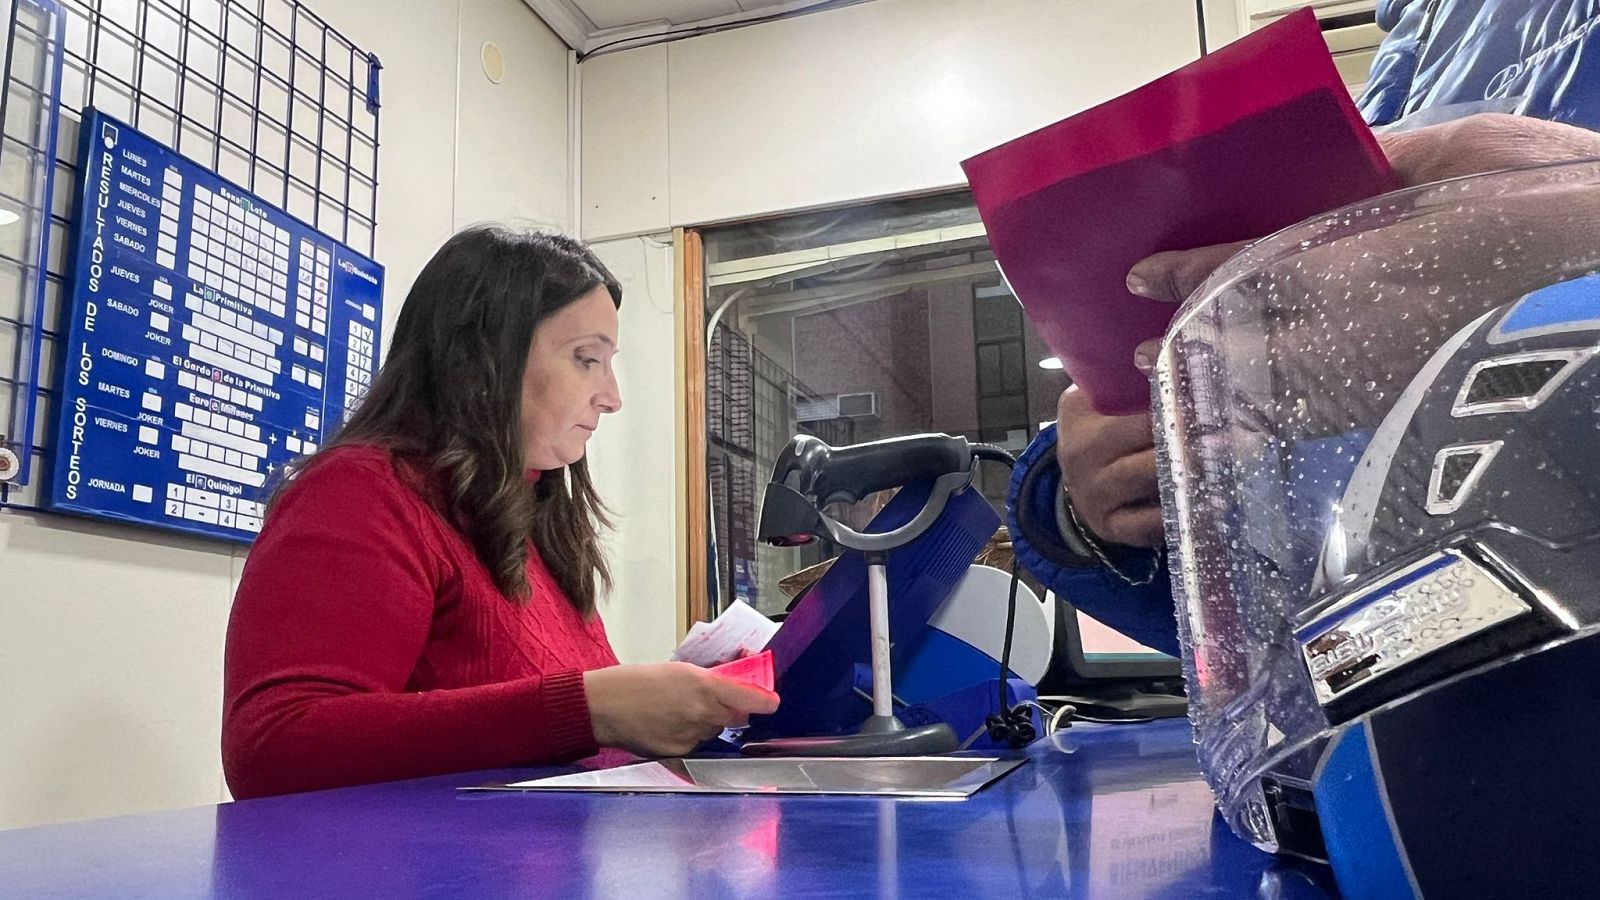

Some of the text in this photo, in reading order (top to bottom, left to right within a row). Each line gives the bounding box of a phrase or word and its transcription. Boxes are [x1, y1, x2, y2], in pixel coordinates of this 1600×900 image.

[122, 148, 148, 167] LUNES
[121, 165, 151, 187] MARTES
[119, 182, 161, 208] MIERCOLES
[117, 199, 146, 218] JUEVES
[115, 216, 148, 236] VIERNES
[113, 233, 146, 253] SABADO
[110, 266, 140, 283] JUEVES
[106, 298, 139, 317] SABADO
[148, 299, 174, 314] JOKER
[193, 283, 253, 316] La Primitiva
[66, 152, 113, 500] RESULTADOS DE LOS SORTEOS
[145, 331, 171, 346] JOKER
[101, 348, 139, 366] DOMINGO
[172, 355, 182, 367] El
[184, 359, 211, 376] Gordo
[223, 374, 234, 384] de
[236, 377, 243, 387] la
[245, 381, 281, 400] Primitiva
[98, 382, 130, 399] MARTES
[189, 392, 209, 407] Euro
[95, 417, 128, 433] VIERNES
[136, 412, 164, 426] JOKER
[133, 446, 160, 459] JOKER
[88, 478, 126, 494] JORNADA
[186, 473, 242, 495] El Quinigol
